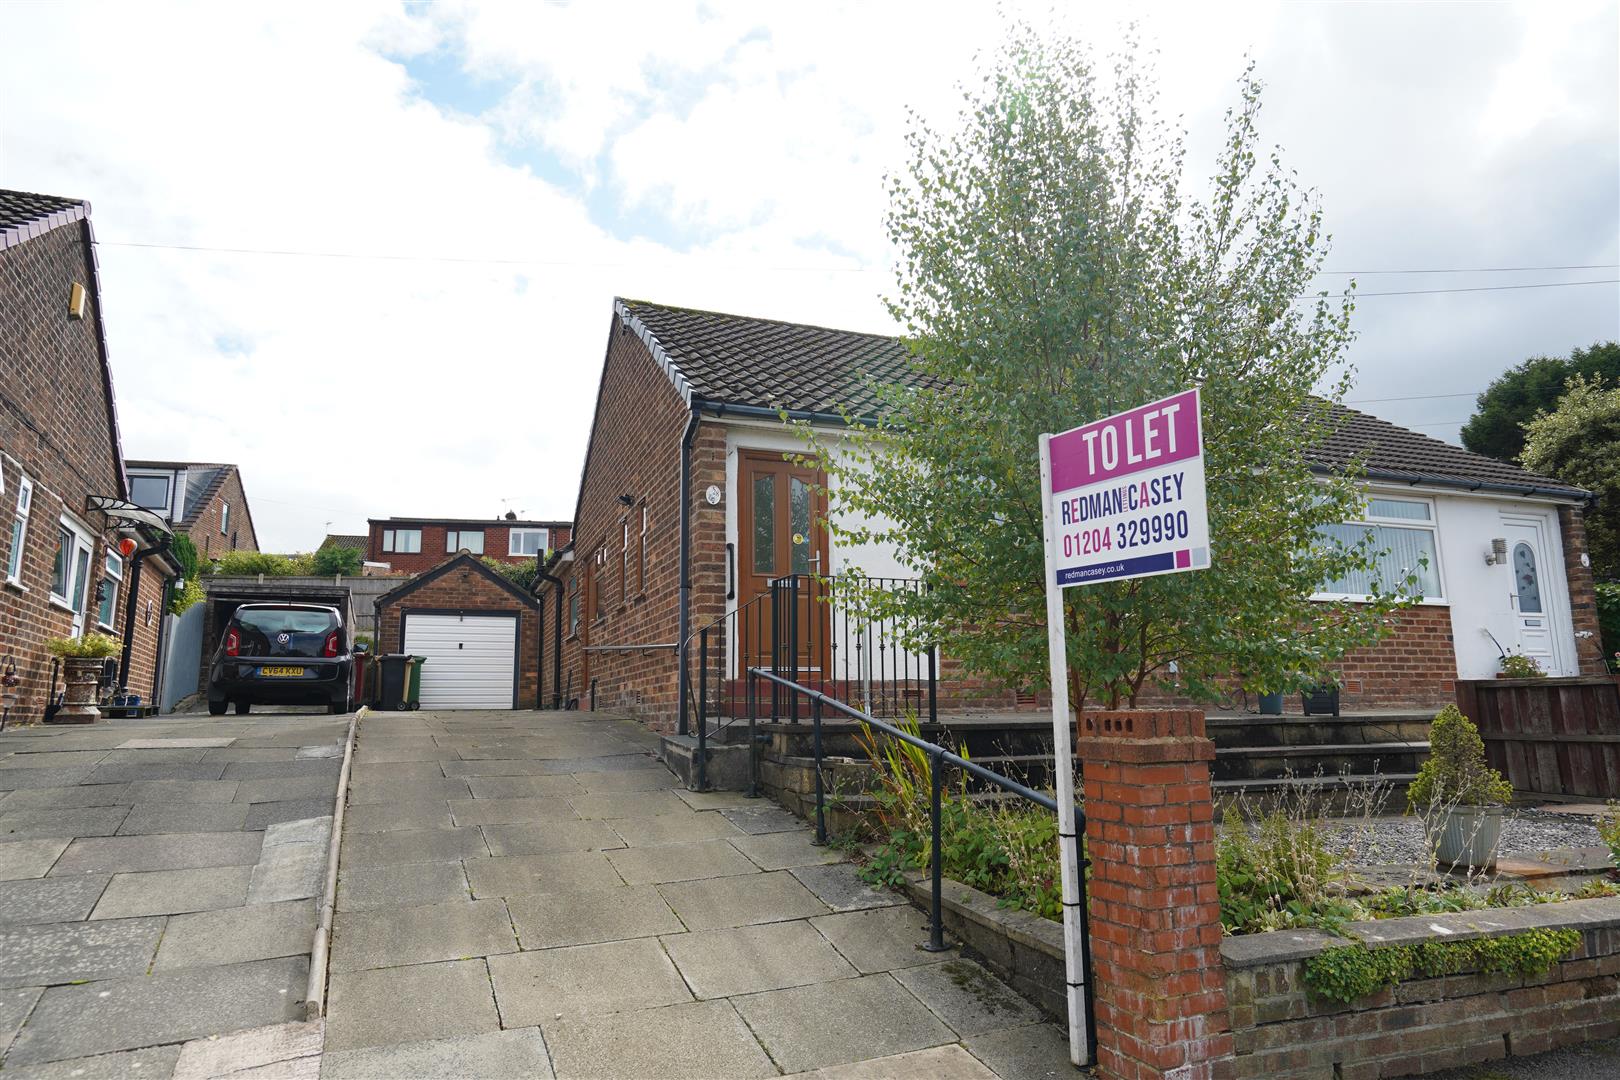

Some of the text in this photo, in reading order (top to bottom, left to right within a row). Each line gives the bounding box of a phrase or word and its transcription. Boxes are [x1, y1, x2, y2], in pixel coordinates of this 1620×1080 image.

[1082, 403, 1180, 475] TO LET
[1061, 472, 1184, 525] REDMAN CASEY
[1063, 510, 1189, 558] 01204 329990
[1064, 563, 1125, 579] redmancasey.co.uk
[262, 667, 302, 675] CV64 KXU
